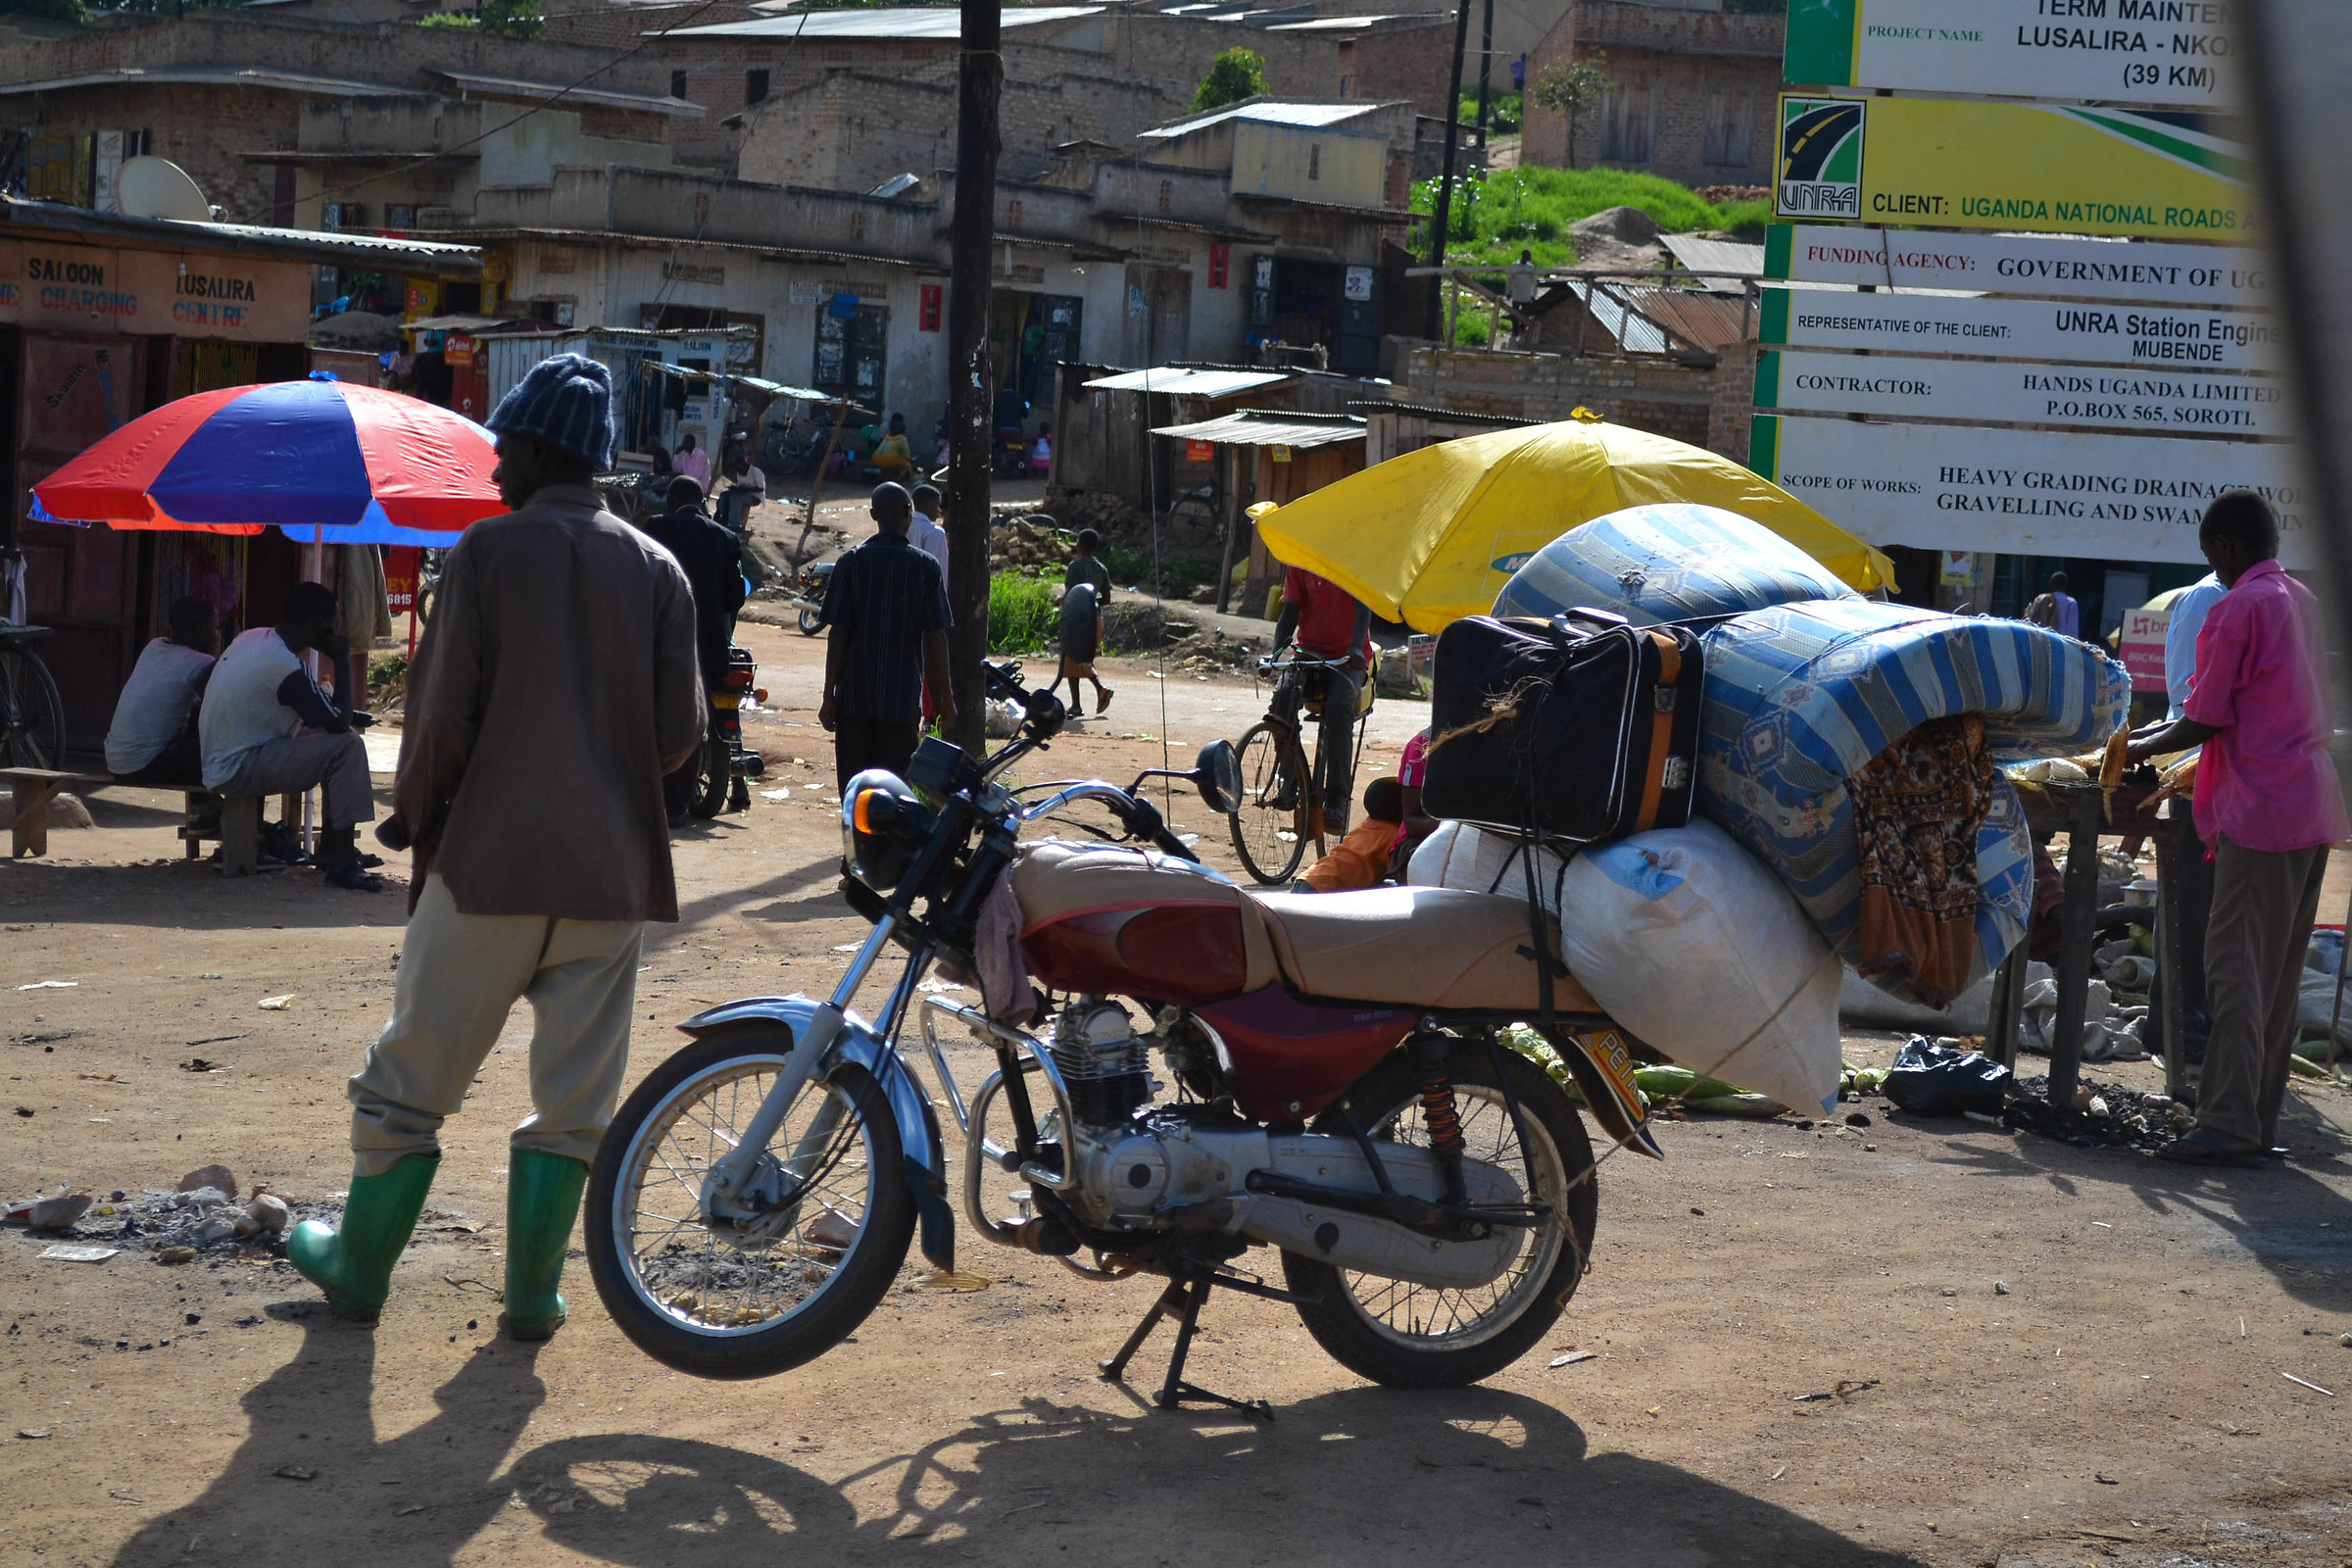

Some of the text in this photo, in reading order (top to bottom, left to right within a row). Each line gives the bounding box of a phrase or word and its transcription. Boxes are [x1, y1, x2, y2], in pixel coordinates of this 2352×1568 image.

[2034, 0, 2107, 18] TERM
[1868, 24, 1984, 43] PROJECT NAME
[2017, 25, 2147, 52] LUSALIRA
[2123, 63, 2216, 93] (39 KM)
[1780, 183, 1857, 214] UNRA
[1873, 193, 1949, 215] CLIENT:
[1961, 197, 2049, 220] UGANDA
[2055, 202, 2158, 225] NATIONAL
[2164, 207, 2236, 229] ROADS
[29, 258, 104, 286] SALOON
[1807, 246, 1889, 267] FUNDING
[1893, 252, 1976, 271] AGENCY:
[1996, 257, 2181, 285] GOVERNMENT
[2188, 268, 2223, 287] OF
[40, 285, 138, 317] CHARGING
[1797, 316, 1910, 333] REPRESENTATIVE
[1913, 320, 1932, 334] OF
[1935, 321, 1959, 336] THE
[1962, 323, 2012, 339] CLIENT:
[2055, 310, 2119, 335] UNRA
[2126, 314, 2200, 340] Station
[2132, 340, 2224, 363] MUBENDE
[1795, 374, 2281, 404] CONTRACTOR: HANDS UGANDA LIMITED
[2046, 400, 2256, 427] P.O.BOX 565, SOROTI.
[1783, 474, 1832, 489] SCOPE
[1836, 477, 1857, 490] OF
[1861, 479, 1922, 494] WORKS:
[1938, 466, 2018, 488] HEAVY
[2023, 470, 2127, 495] GRADING
[1936, 493, 2084, 519] GRAVELLING
[2090, 503, 2137, 521] AND
